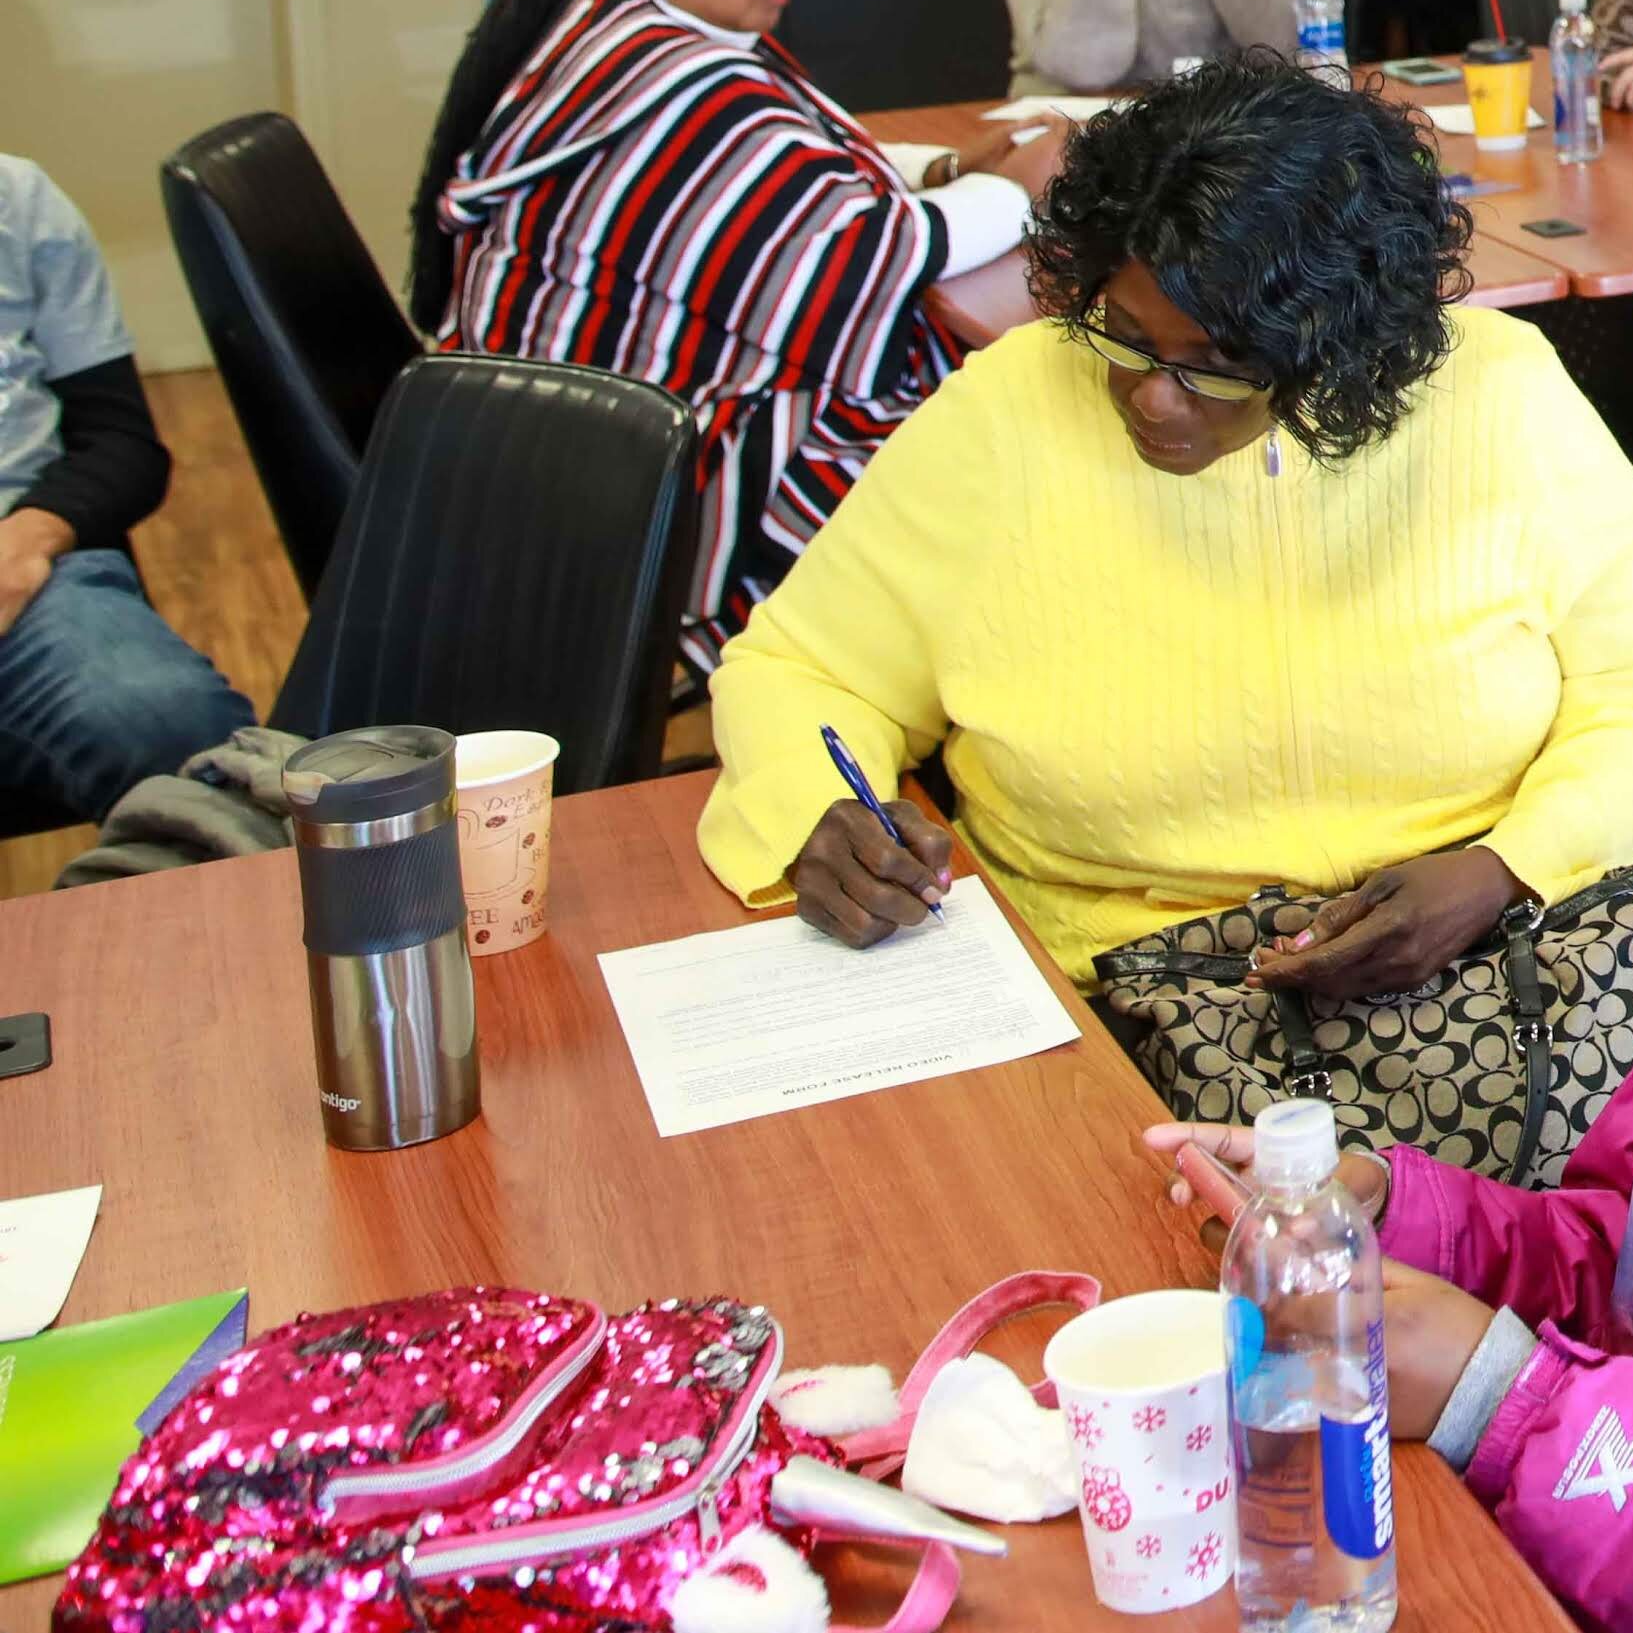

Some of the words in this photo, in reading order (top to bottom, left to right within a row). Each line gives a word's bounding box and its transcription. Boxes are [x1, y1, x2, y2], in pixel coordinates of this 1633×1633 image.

[907, 1054, 953, 1069] VIDEO
[831, 1064, 903, 1084] RELEASE
[782, 1081, 827, 1096] FORM
